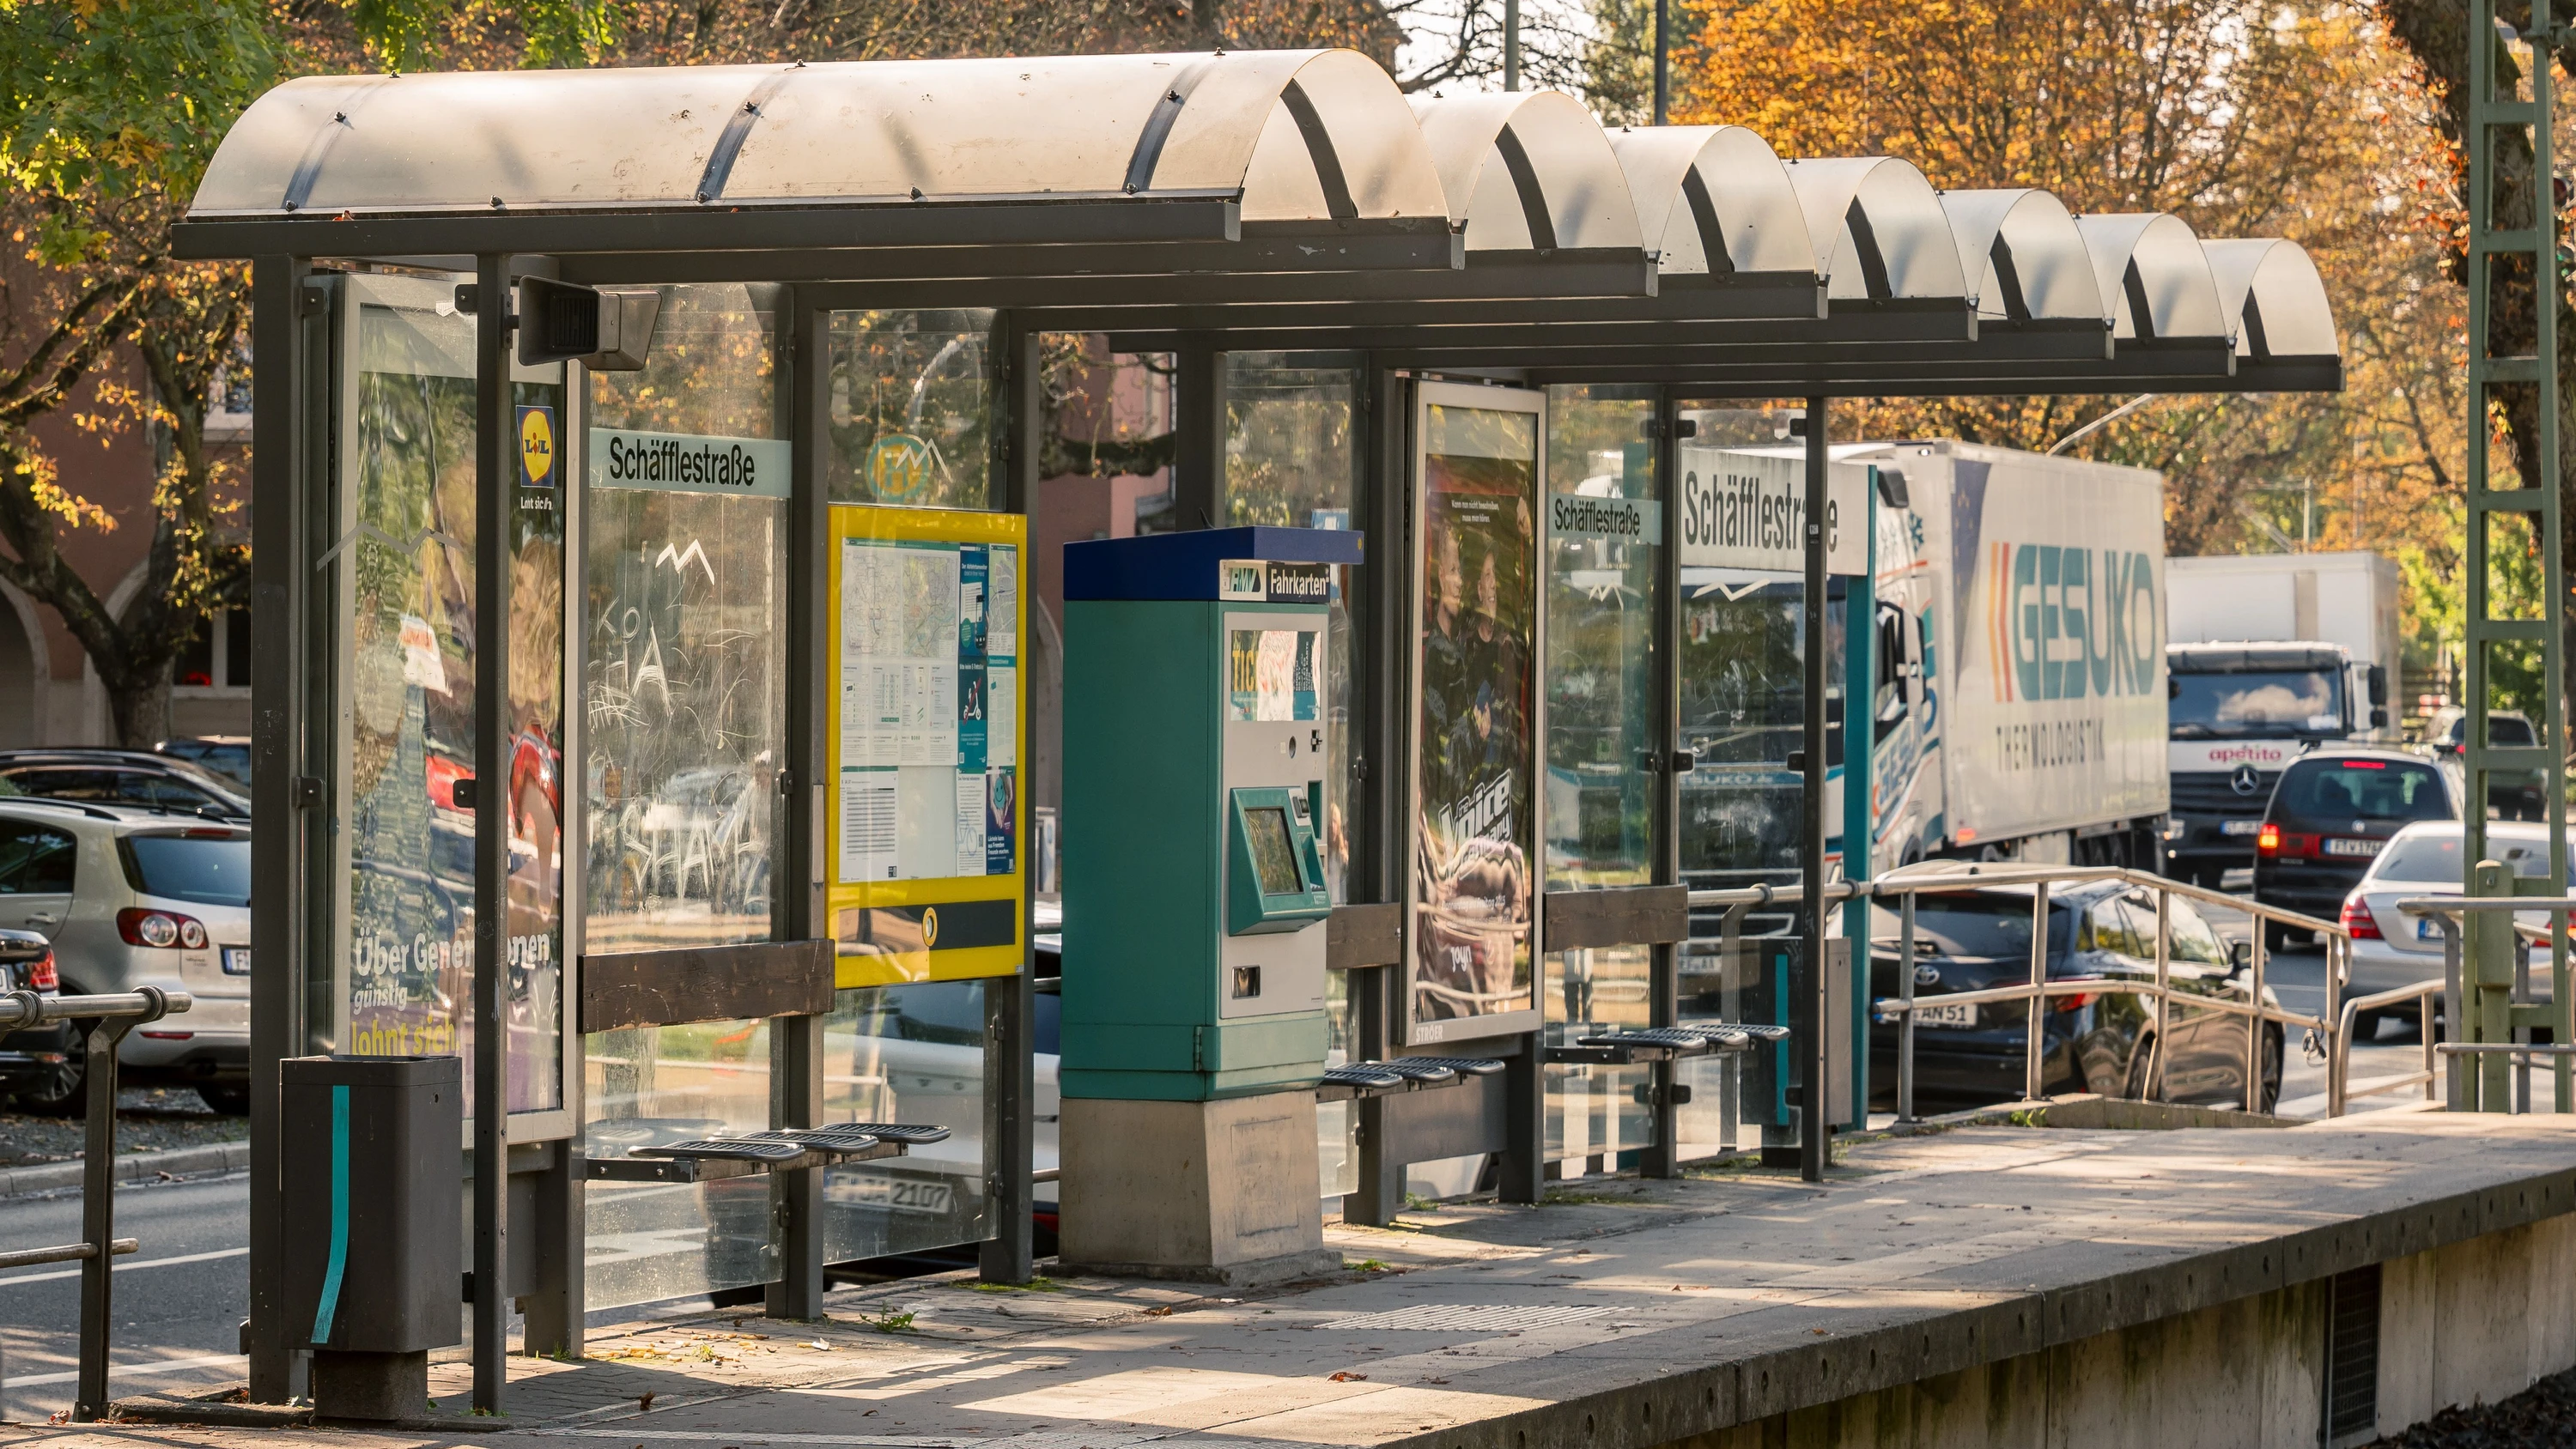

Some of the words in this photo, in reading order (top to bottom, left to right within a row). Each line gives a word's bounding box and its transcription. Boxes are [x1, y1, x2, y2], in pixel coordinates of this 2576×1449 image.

[610, 436, 755, 486] Schäfflestraße
[1555, 498, 1640, 536] Schäfflestraße
[1685, 471, 1838, 553] Schäfflestre
[1271, 568, 1327, 596] Fahrkarten
[2014, 543, 2156, 701] GESUKO
[2209, 747, 2281, 764] apetito
[355, 926, 410, 976] Über
[354, 979, 408, 1016] günstig
[1947, 1005, 1966, 1022] 51
[351, 1019, 408, 1056] lohnt
[413, 1012, 461, 1055] sich.
[892, 1181, 949, 1209] 2107
